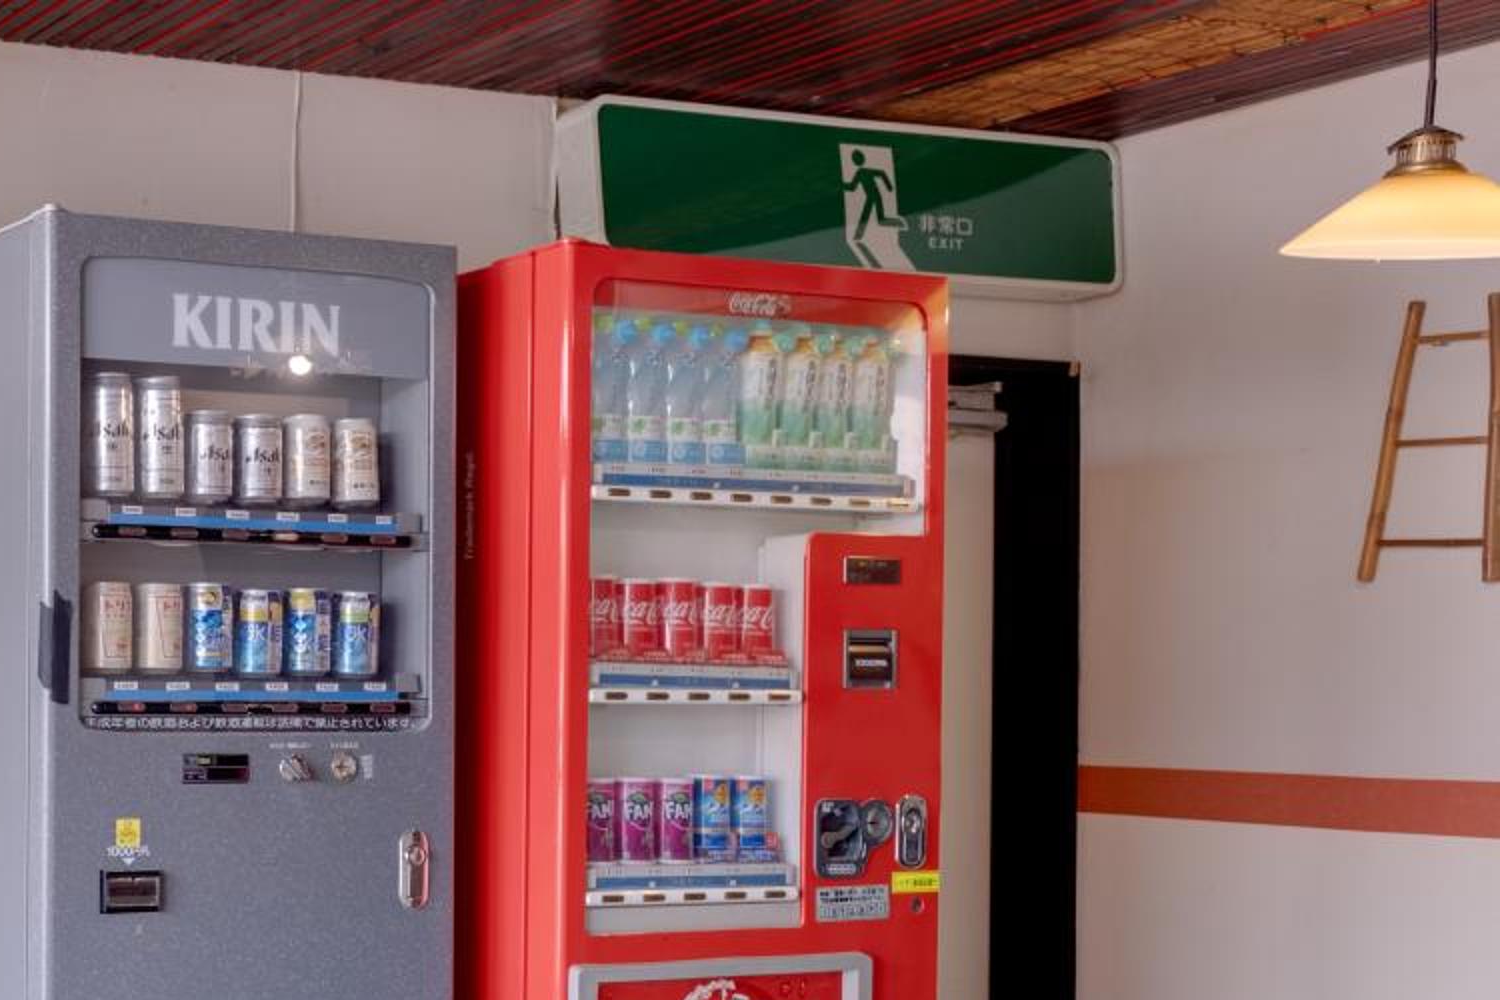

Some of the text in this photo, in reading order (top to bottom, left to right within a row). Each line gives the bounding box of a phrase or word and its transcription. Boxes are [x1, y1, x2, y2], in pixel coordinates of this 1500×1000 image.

[917, 213, 974, 236] 非常口
[928, 238, 965, 250] EXIT
[171, 292, 341, 358] KIRIN
